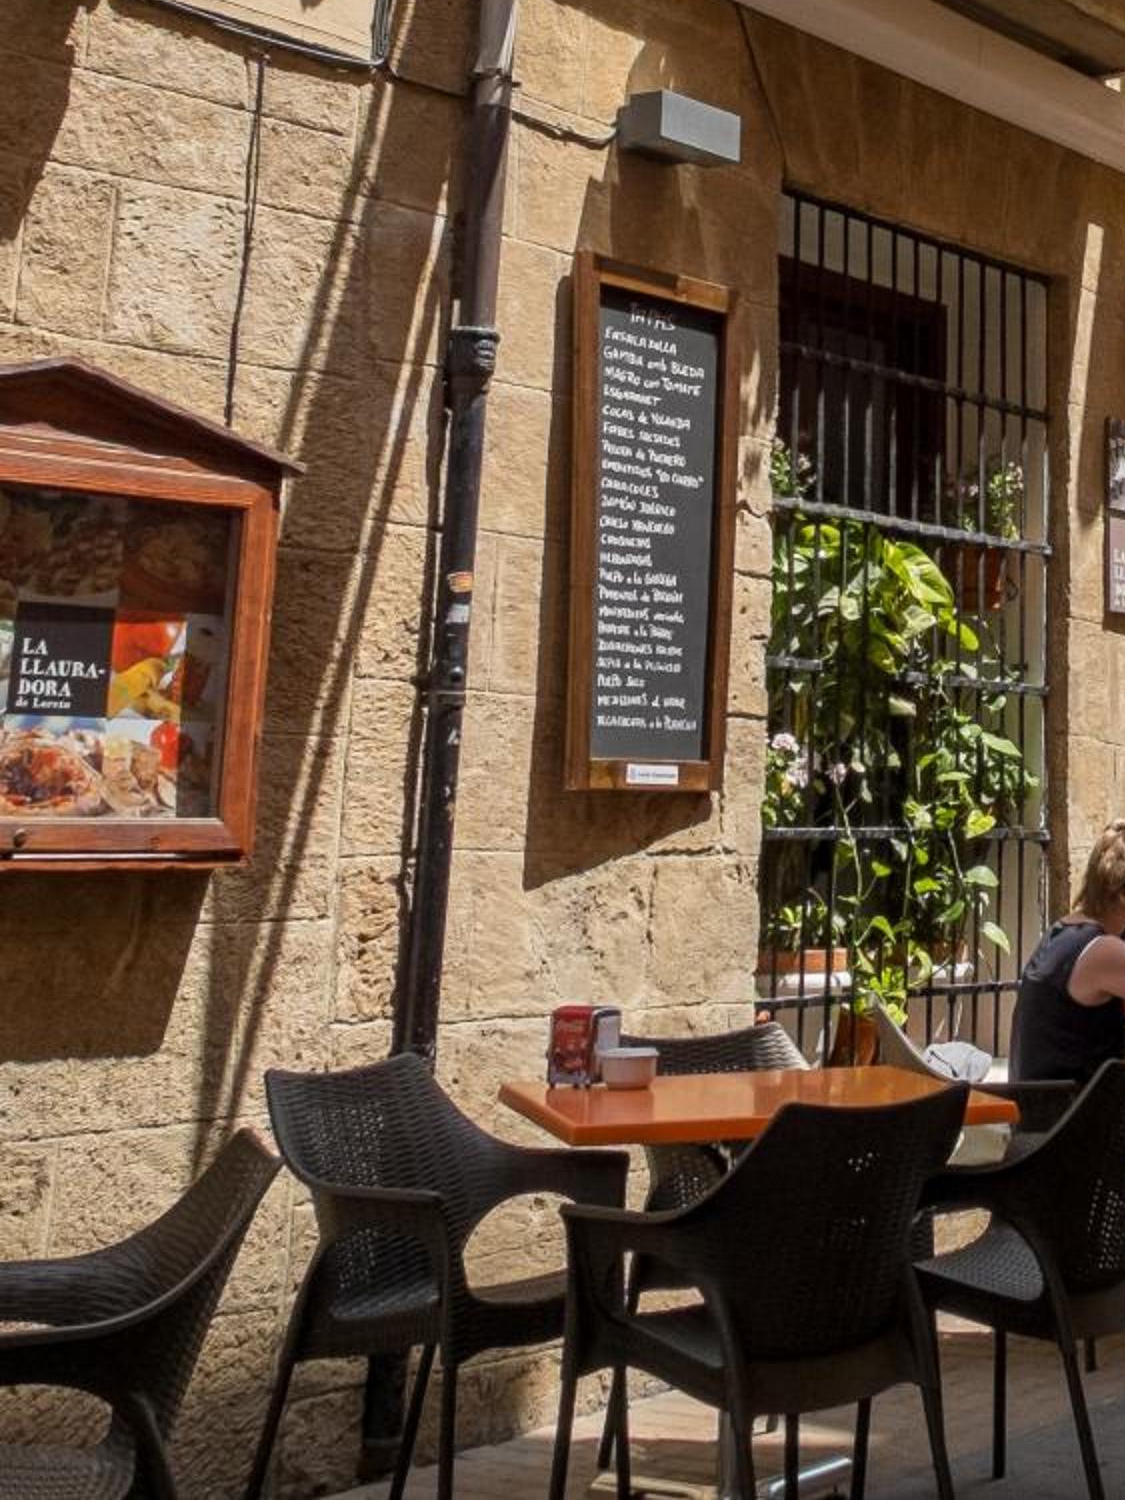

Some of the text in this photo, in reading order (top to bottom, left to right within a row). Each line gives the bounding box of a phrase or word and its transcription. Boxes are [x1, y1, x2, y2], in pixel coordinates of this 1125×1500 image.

[22, 637, 48, 655] LA
[20, 658, 105, 679] LLAURA-
[17, 678, 71, 697] DORA
